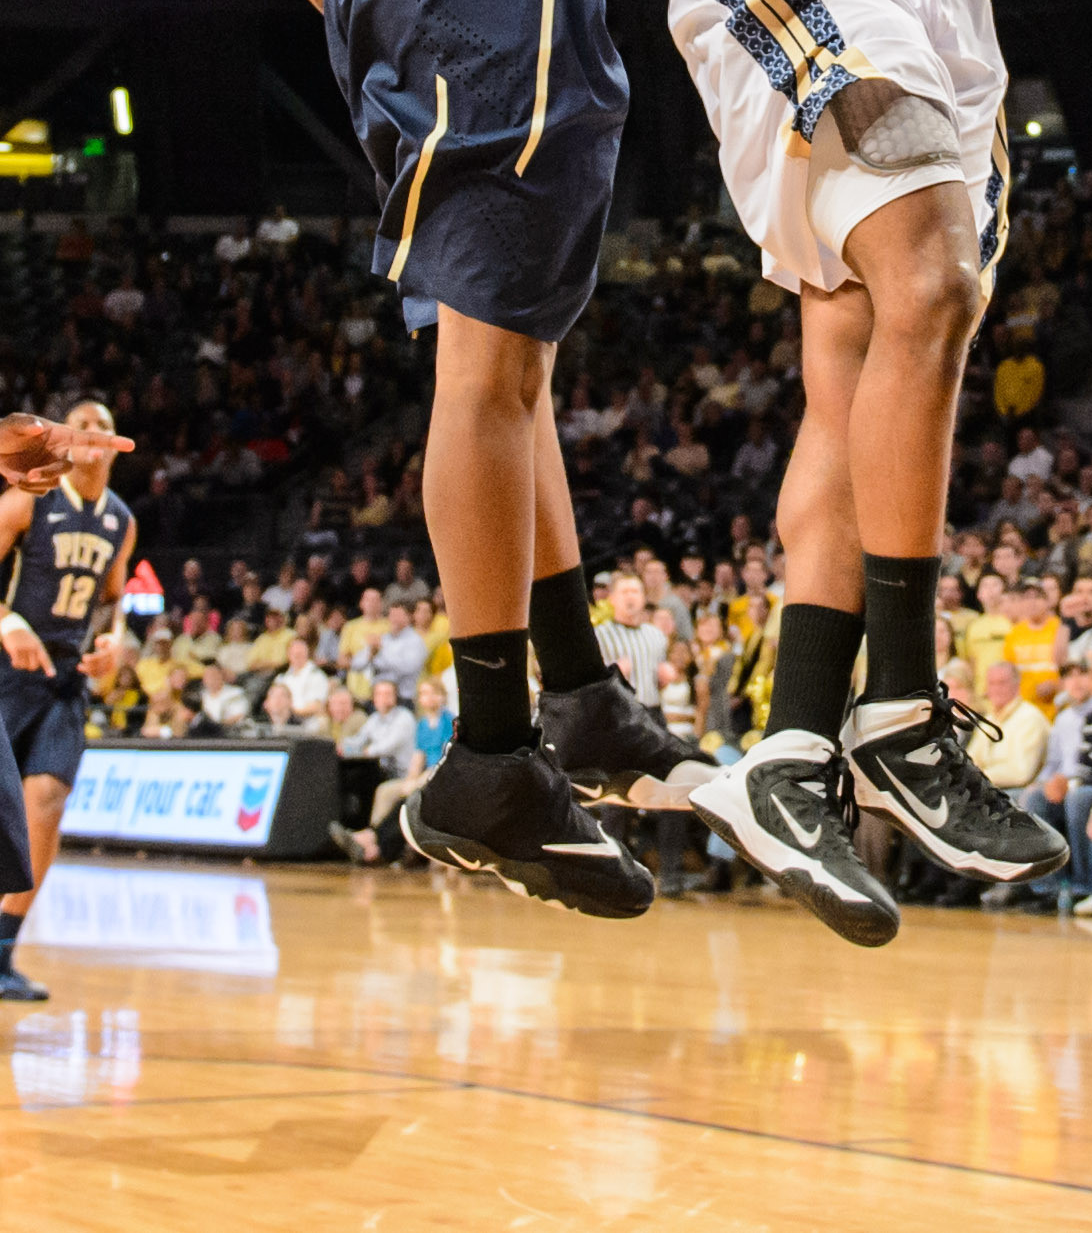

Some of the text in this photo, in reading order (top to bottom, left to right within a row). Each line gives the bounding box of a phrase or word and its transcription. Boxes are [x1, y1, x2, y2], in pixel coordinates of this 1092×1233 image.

[52, 531, 114, 574] PITT
[51, 573, 96, 620] 12
[69, 764, 226, 827] re for your car.
